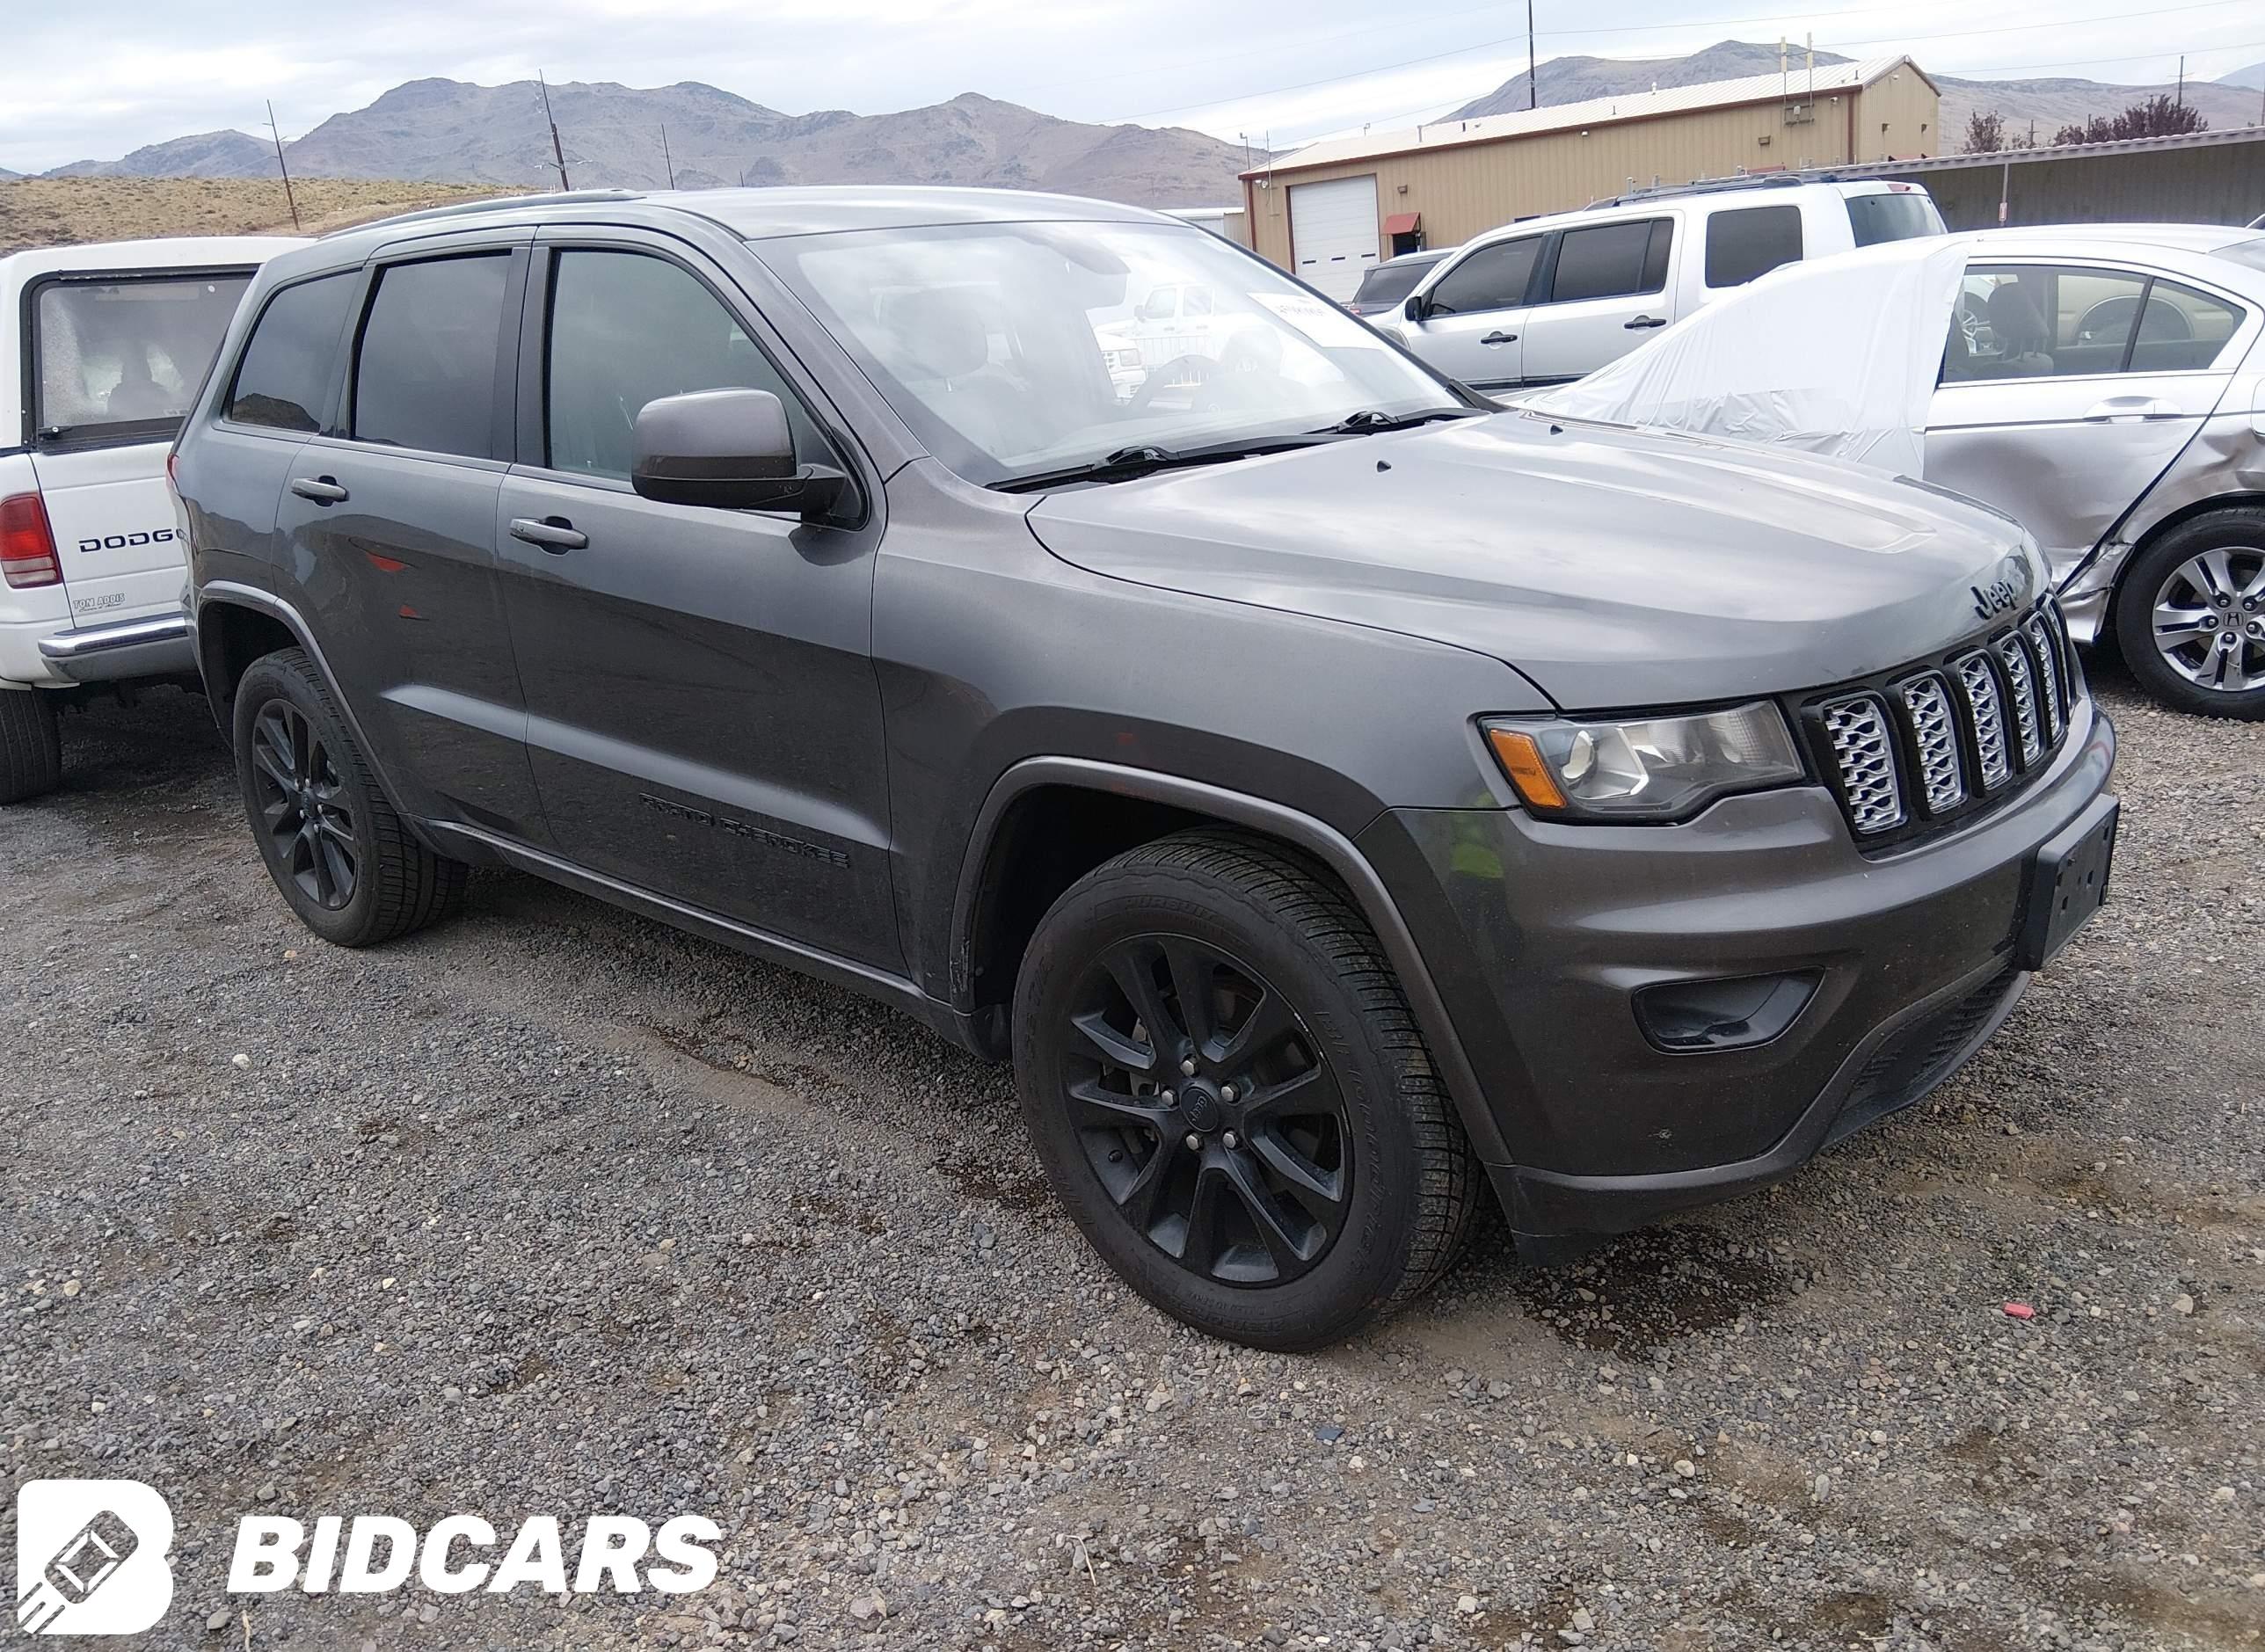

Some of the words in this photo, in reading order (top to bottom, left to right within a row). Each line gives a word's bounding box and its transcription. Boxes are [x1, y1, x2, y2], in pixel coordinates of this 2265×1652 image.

[78, 528, 173, 553] DODG
[73, 598, 94, 609] TOM
[97, 593, 125, 606] ADDIS
[1970, 579, 2020, 621] Jeep
[720, 818, 851, 870] CHEROKEE
